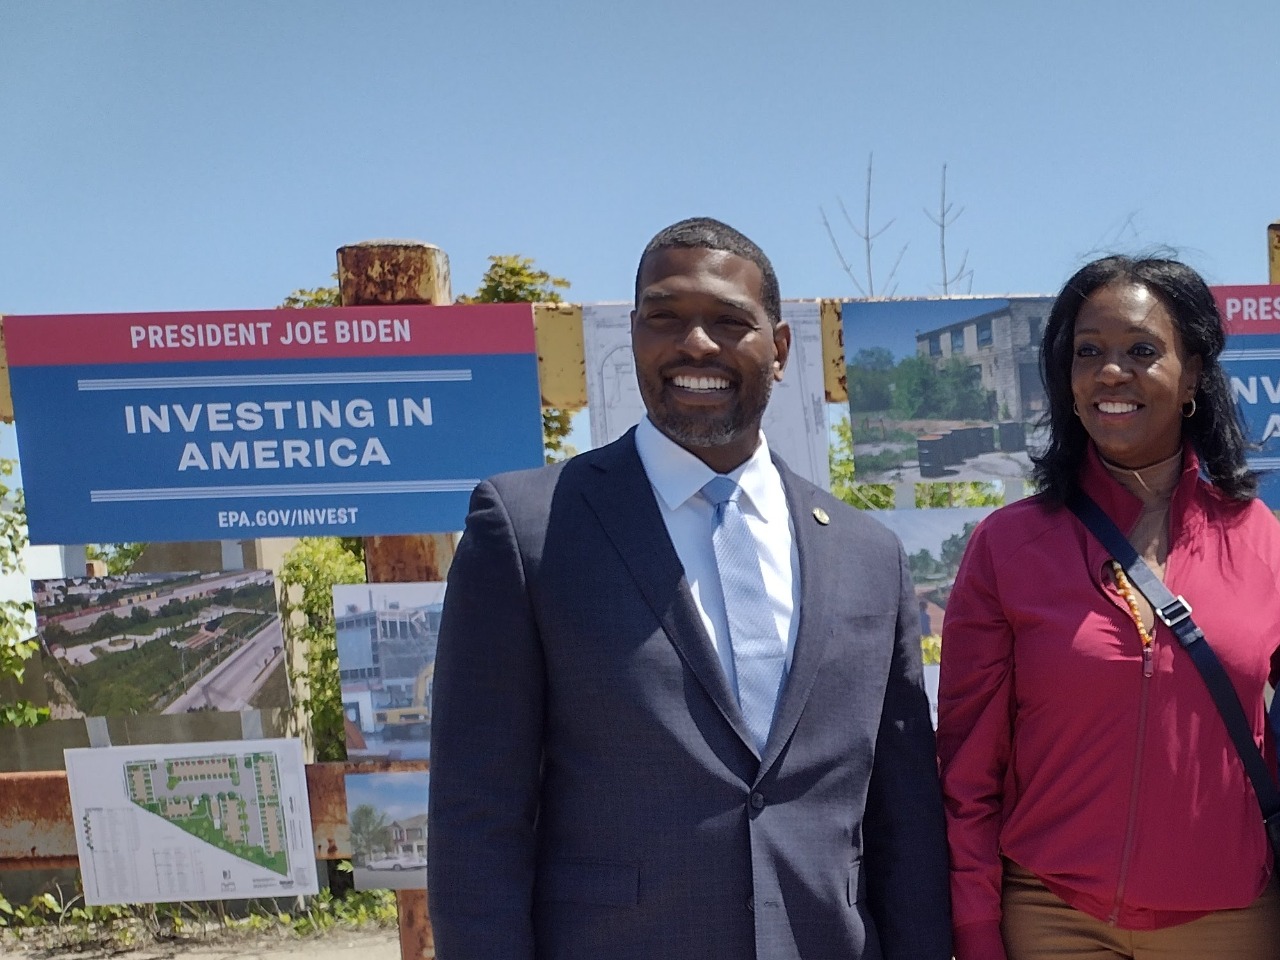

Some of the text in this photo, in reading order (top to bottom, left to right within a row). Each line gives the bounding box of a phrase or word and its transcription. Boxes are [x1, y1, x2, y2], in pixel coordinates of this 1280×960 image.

[130, 319, 412, 348] PRESIDENT JOE BIDEN
[124, 397, 433, 434] INVESTING IN
[178, 437, 391, 472] AMERICA
[218, 507, 359, 528] EPA.GOV/INVEST
